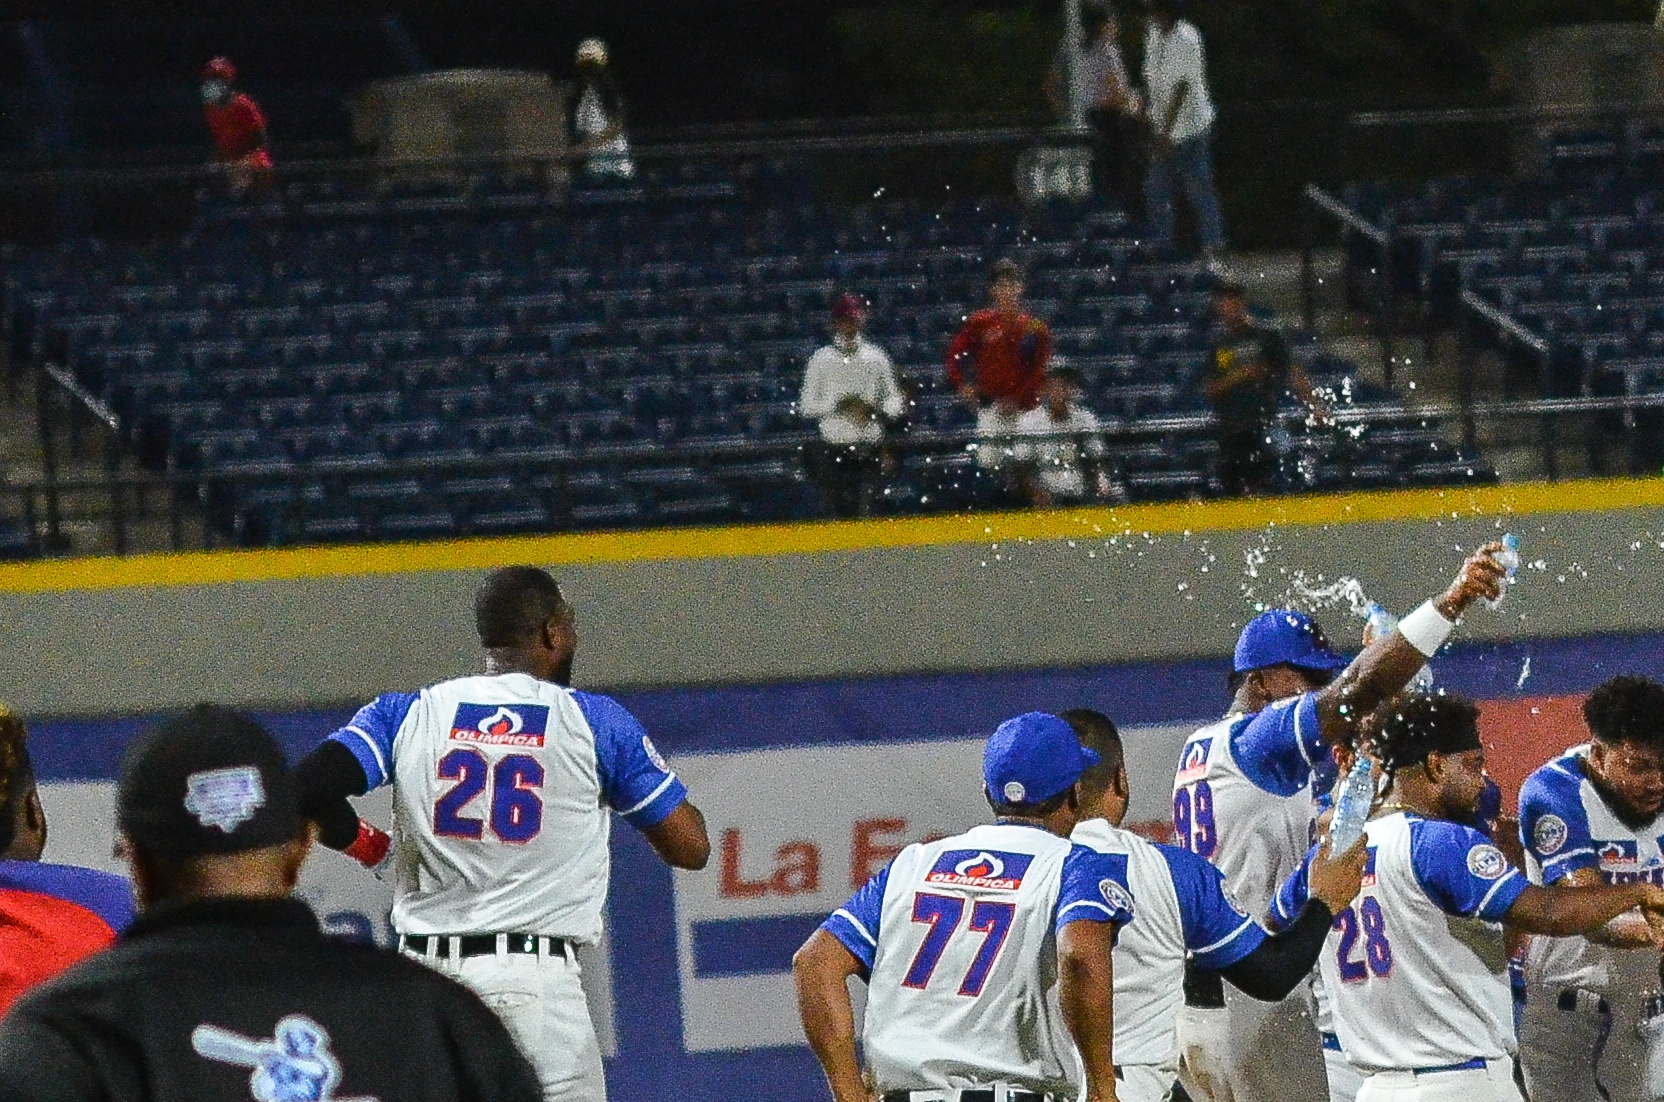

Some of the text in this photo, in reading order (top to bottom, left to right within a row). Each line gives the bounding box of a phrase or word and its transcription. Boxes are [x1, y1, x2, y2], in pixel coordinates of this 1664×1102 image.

[454, 730, 540, 746] OLIMPICA
[433, 747, 546, 845] 26
[1174, 779, 1218, 858] 99
[719, 827, 823, 900] La
[929, 872, 1015, 890] OLIMPICA
[900, 891, 1017, 997] 77
[1331, 895, 1393, 983] 28
